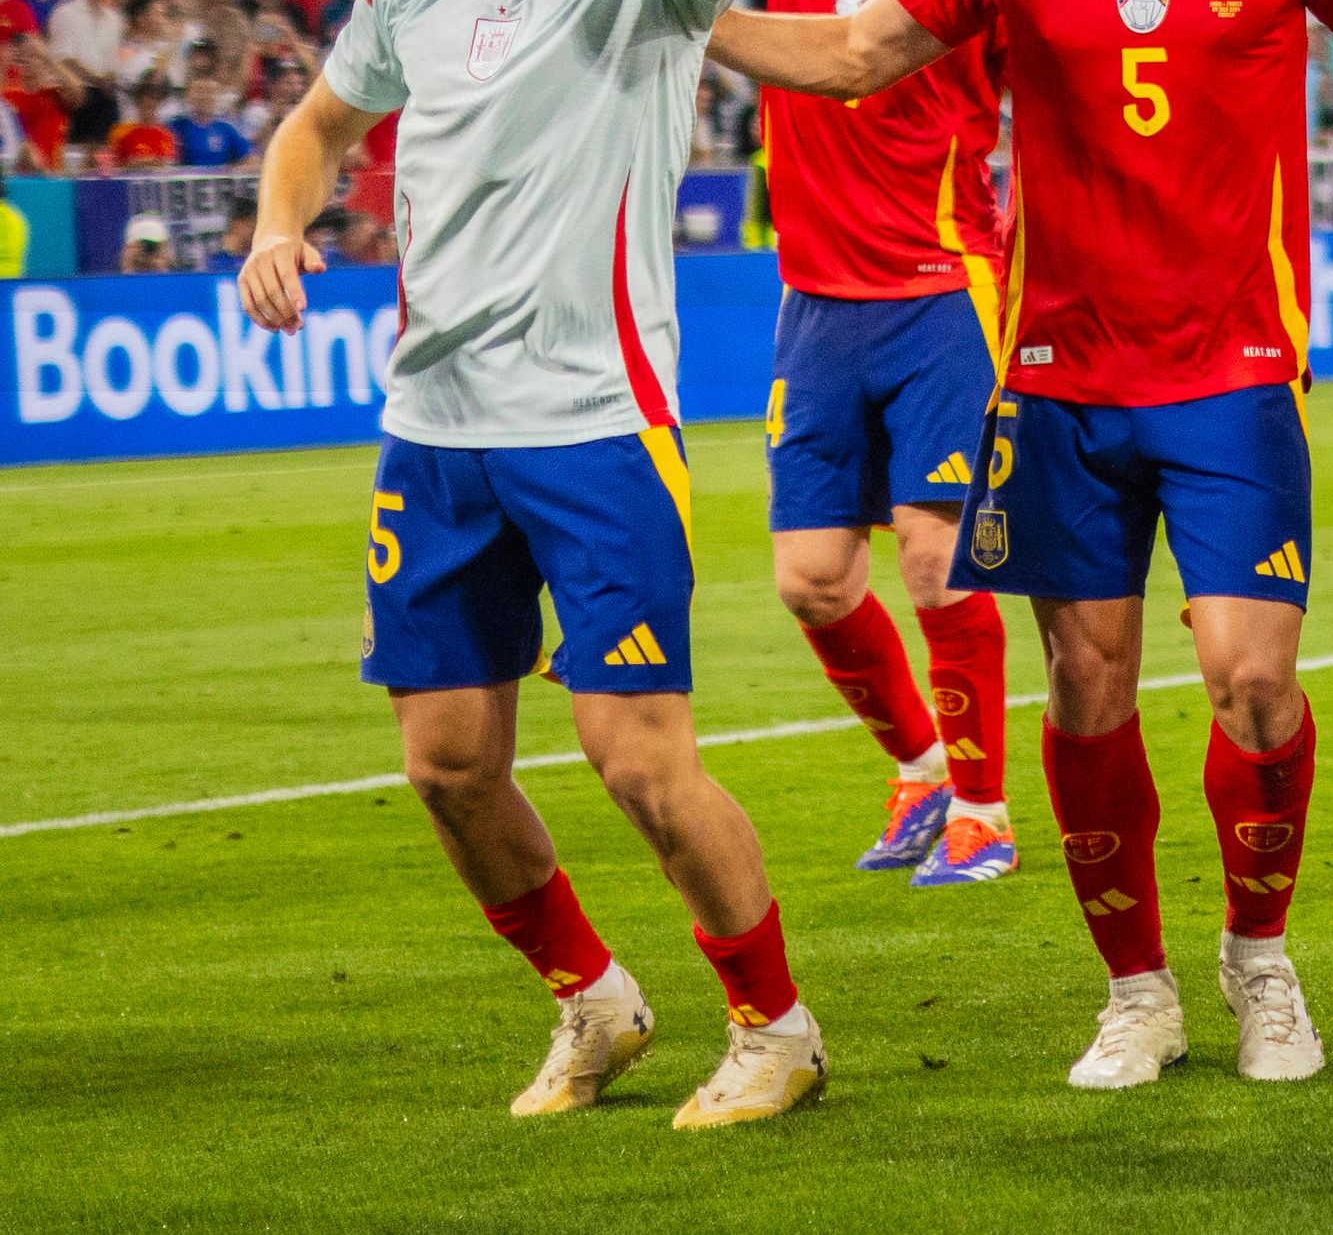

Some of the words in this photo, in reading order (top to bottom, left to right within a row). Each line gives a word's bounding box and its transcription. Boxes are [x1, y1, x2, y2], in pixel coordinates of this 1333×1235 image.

[1121, 47, 1171, 137] 5
[1243, 346, 1282, 358] HEAT.RDY
[765, 378, 786, 448] 4
[367, 490, 405, 584] 5
